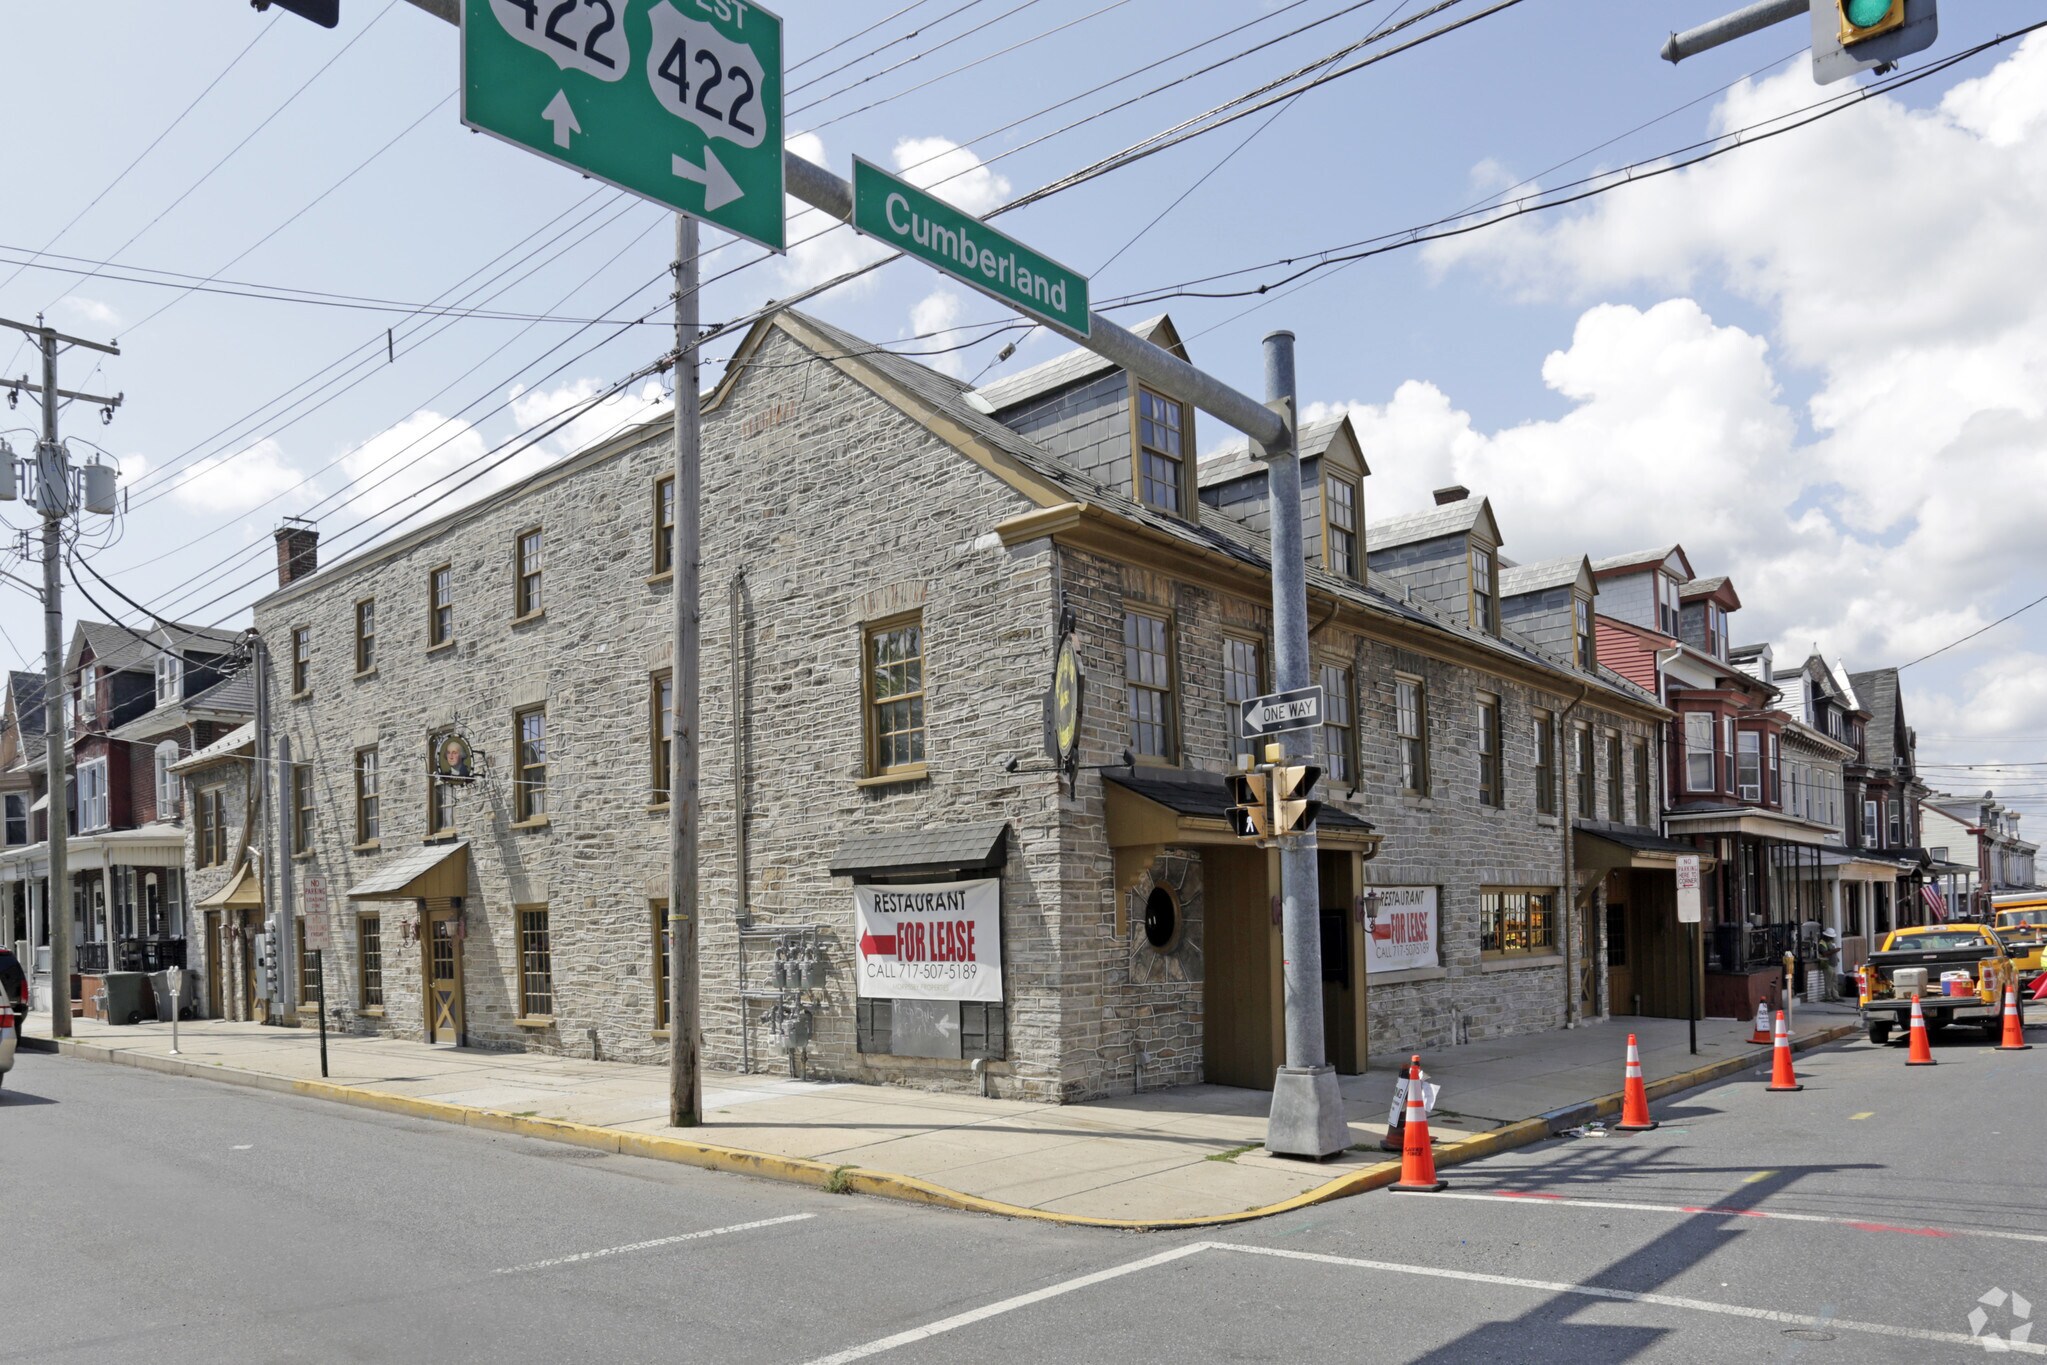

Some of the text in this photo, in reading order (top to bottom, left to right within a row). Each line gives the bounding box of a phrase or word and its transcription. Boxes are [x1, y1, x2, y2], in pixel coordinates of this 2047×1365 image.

[658, 37, 754, 137] 422
[886, 192, 1066, 312] Cumberland
[1264, 700, 1312, 721] ONE WAY
[311, 879, 319, 887] NO
[874, 890, 966, 913] RESTAURANT
[1380, 890, 1424, 906] RESTAURANT
[1391, 912, 1428, 944] FOR LEASE
[897, 920, 976, 962] FOR LEASE
[1376, 946, 1392, 959] CALL
[866, 963, 977, 980] CALL 717-507-5189
